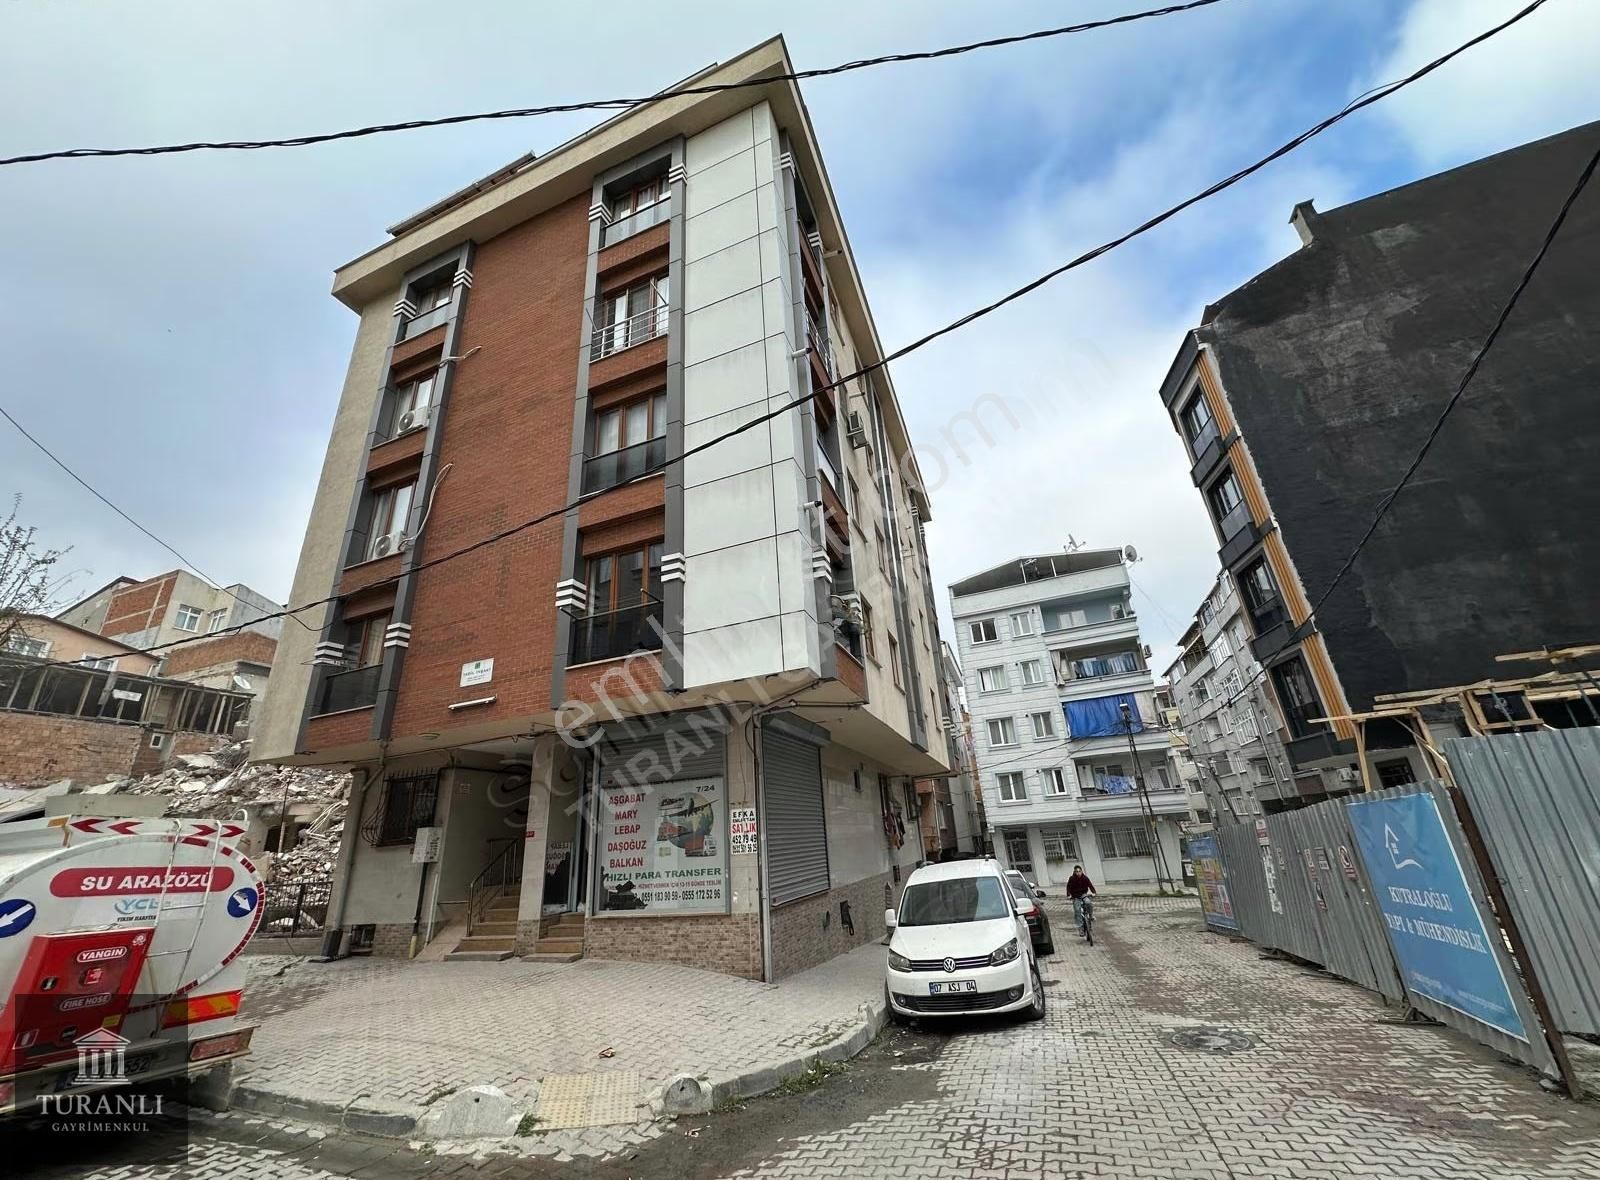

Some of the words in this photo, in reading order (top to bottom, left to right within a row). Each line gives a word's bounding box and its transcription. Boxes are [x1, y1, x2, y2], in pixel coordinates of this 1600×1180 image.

[608, 793, 646, 806] AŞGABAT
[615, 809, 638, 820] MARY
[615, 824, 640, 835] LEBAP
[732, 823, 756, 834] SATLIK
[608, 839, 647, 853] DAŞOĞUZ
[609, 857, 644, 869] BALKAN
[606, 872, 632, 882] HIZLI
[635, 871, 661, 880] PARA
[665, 868, 722, 878] TRANSFER
[81, 876, 113, 890] SU
[682, 890, 694, 900] 0555
[696, 889, 705, 900] 172
[1413, 917, 1488, 954] MÜHENDİSLİK
[82, 948, 123, 960] YANGIN
[948, 982, 961, 992] ASJ
[63, 998, 83, 1009] FIRE
[85, 995, 108, 1006] HOSE
